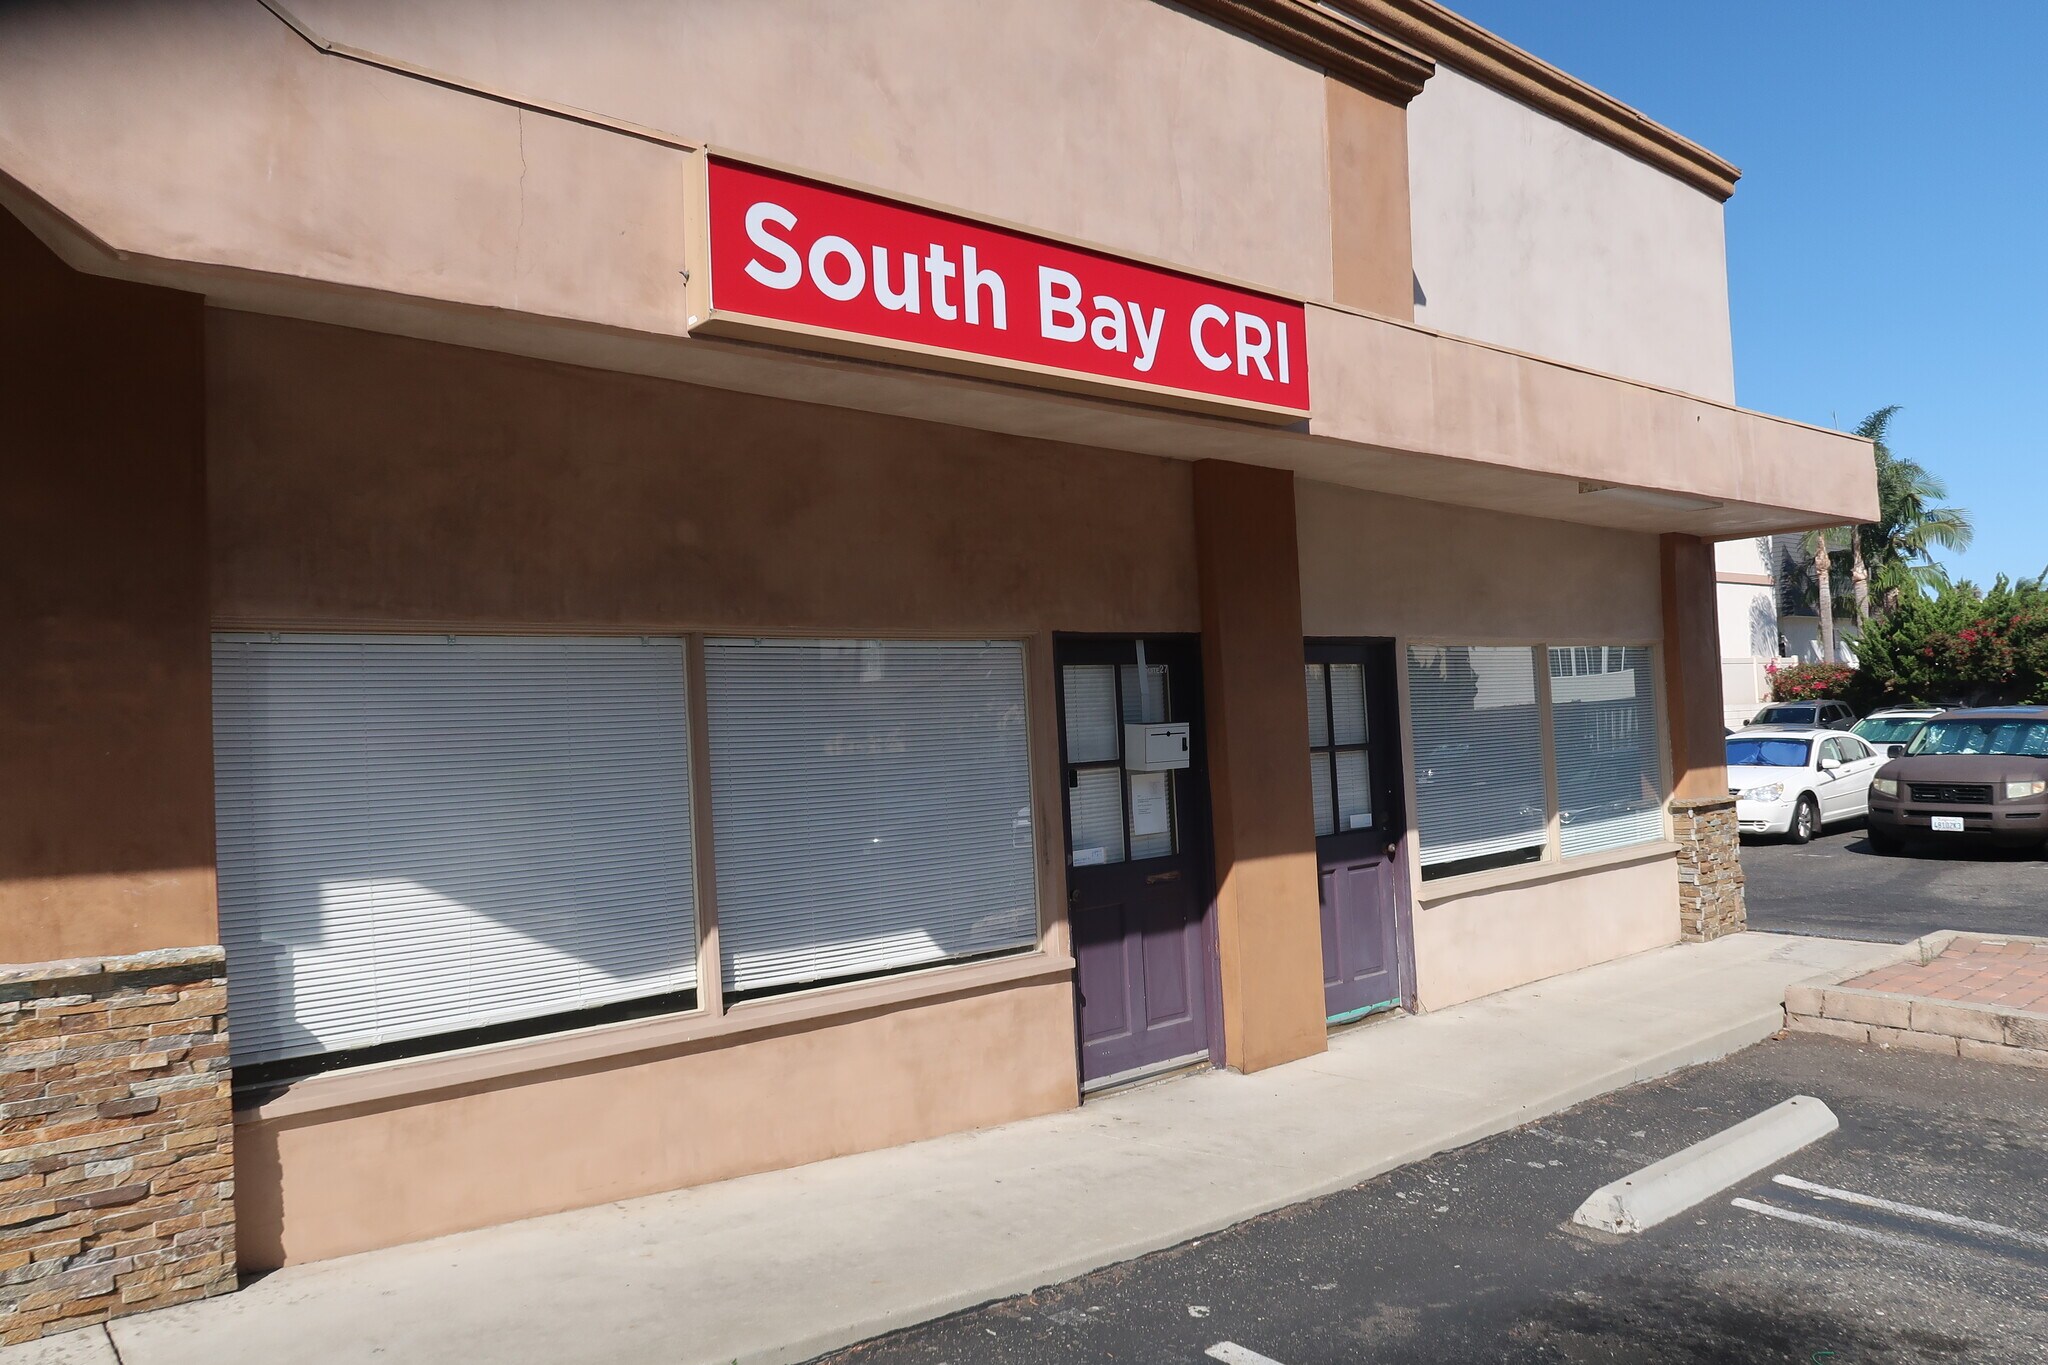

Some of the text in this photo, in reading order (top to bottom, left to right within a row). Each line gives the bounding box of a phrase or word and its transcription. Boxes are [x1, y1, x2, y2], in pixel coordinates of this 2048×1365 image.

[744, 201, 1290, 384] South Bay CRI
